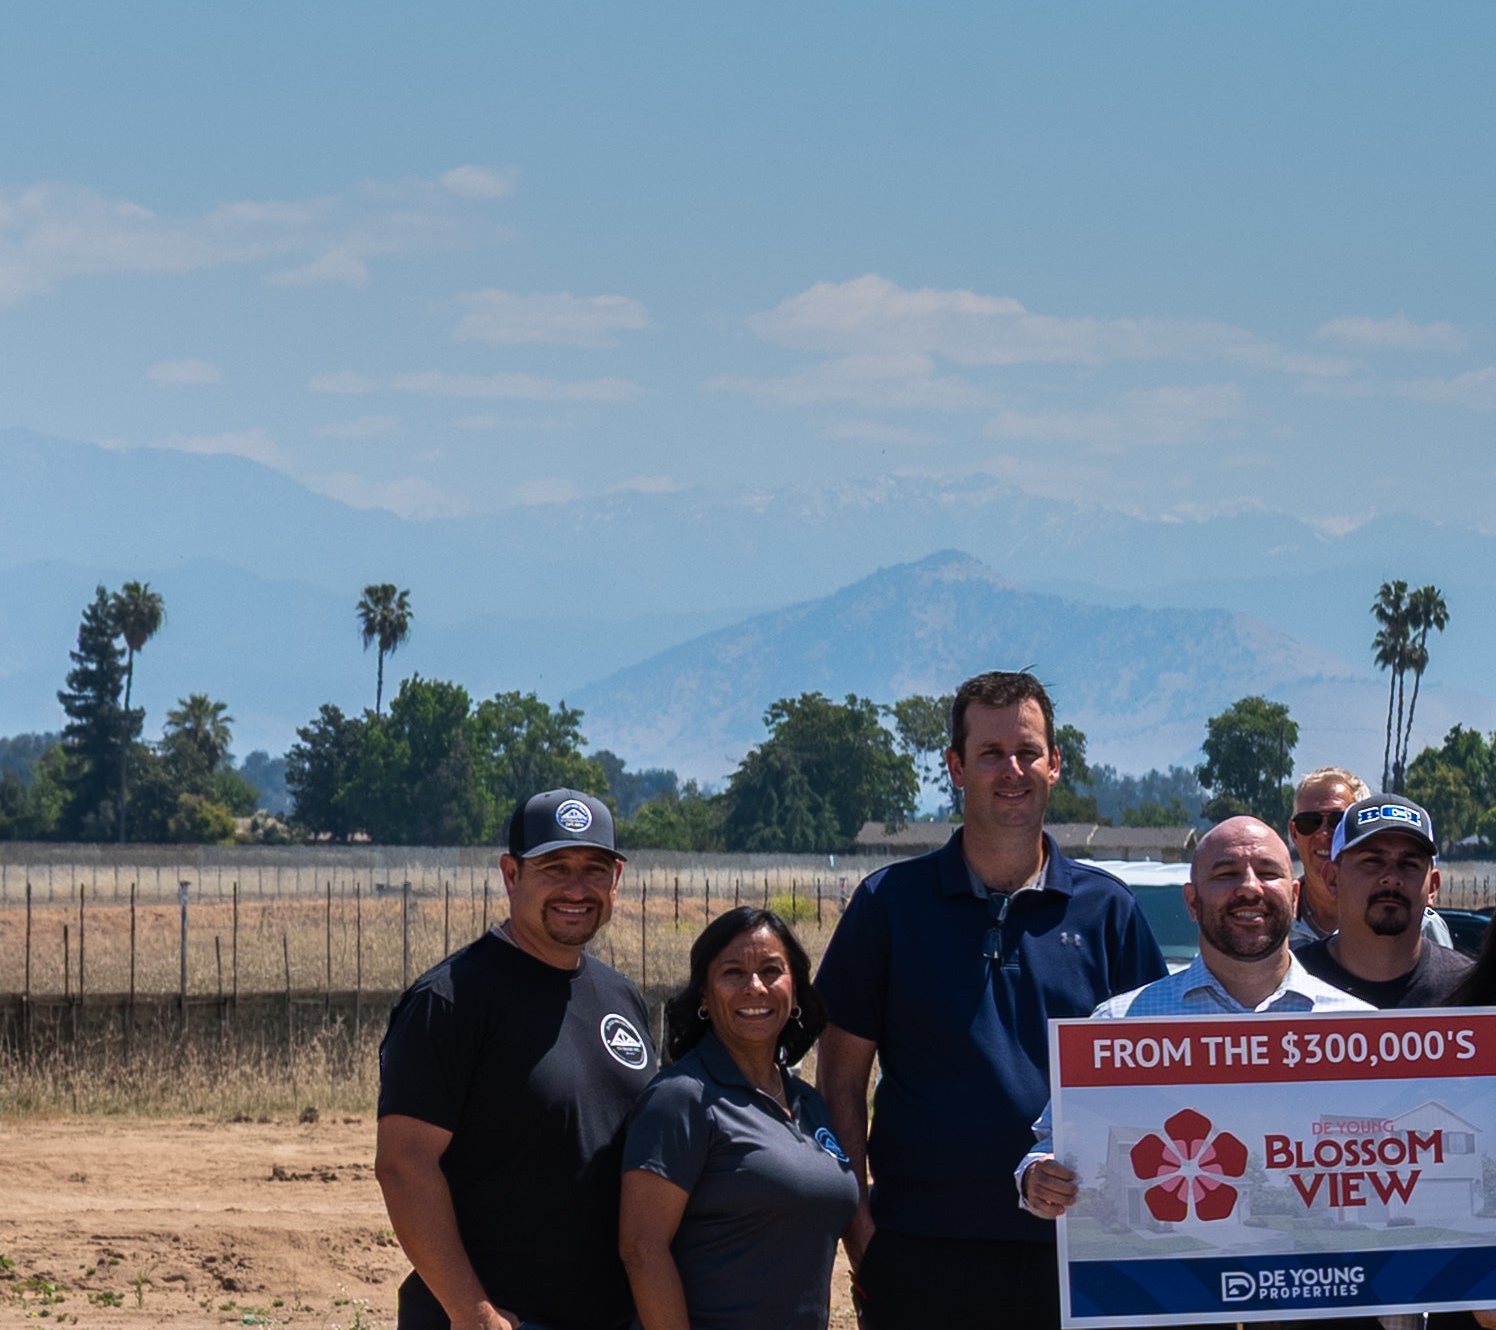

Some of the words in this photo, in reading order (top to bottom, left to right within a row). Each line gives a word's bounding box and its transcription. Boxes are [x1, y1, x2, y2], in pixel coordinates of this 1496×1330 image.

[1093, 1037, 1192, 1069] FROM
[1200, 1035, 1270, 1066] THE
[1281, 1030, 1476, 1068] $300,000'S
[1311, 1121, 1333, 1136] DE
[1336, 1119, 1395, 1135] YOUNG
[1289, 1169, 1422, 1209] VIEW
[1258, 1270, 1286, 1288] DE
[1289, 1266, 1365, 1287] YOUNG
[1259, 1284, 1359, 1300] PROPERTIES
